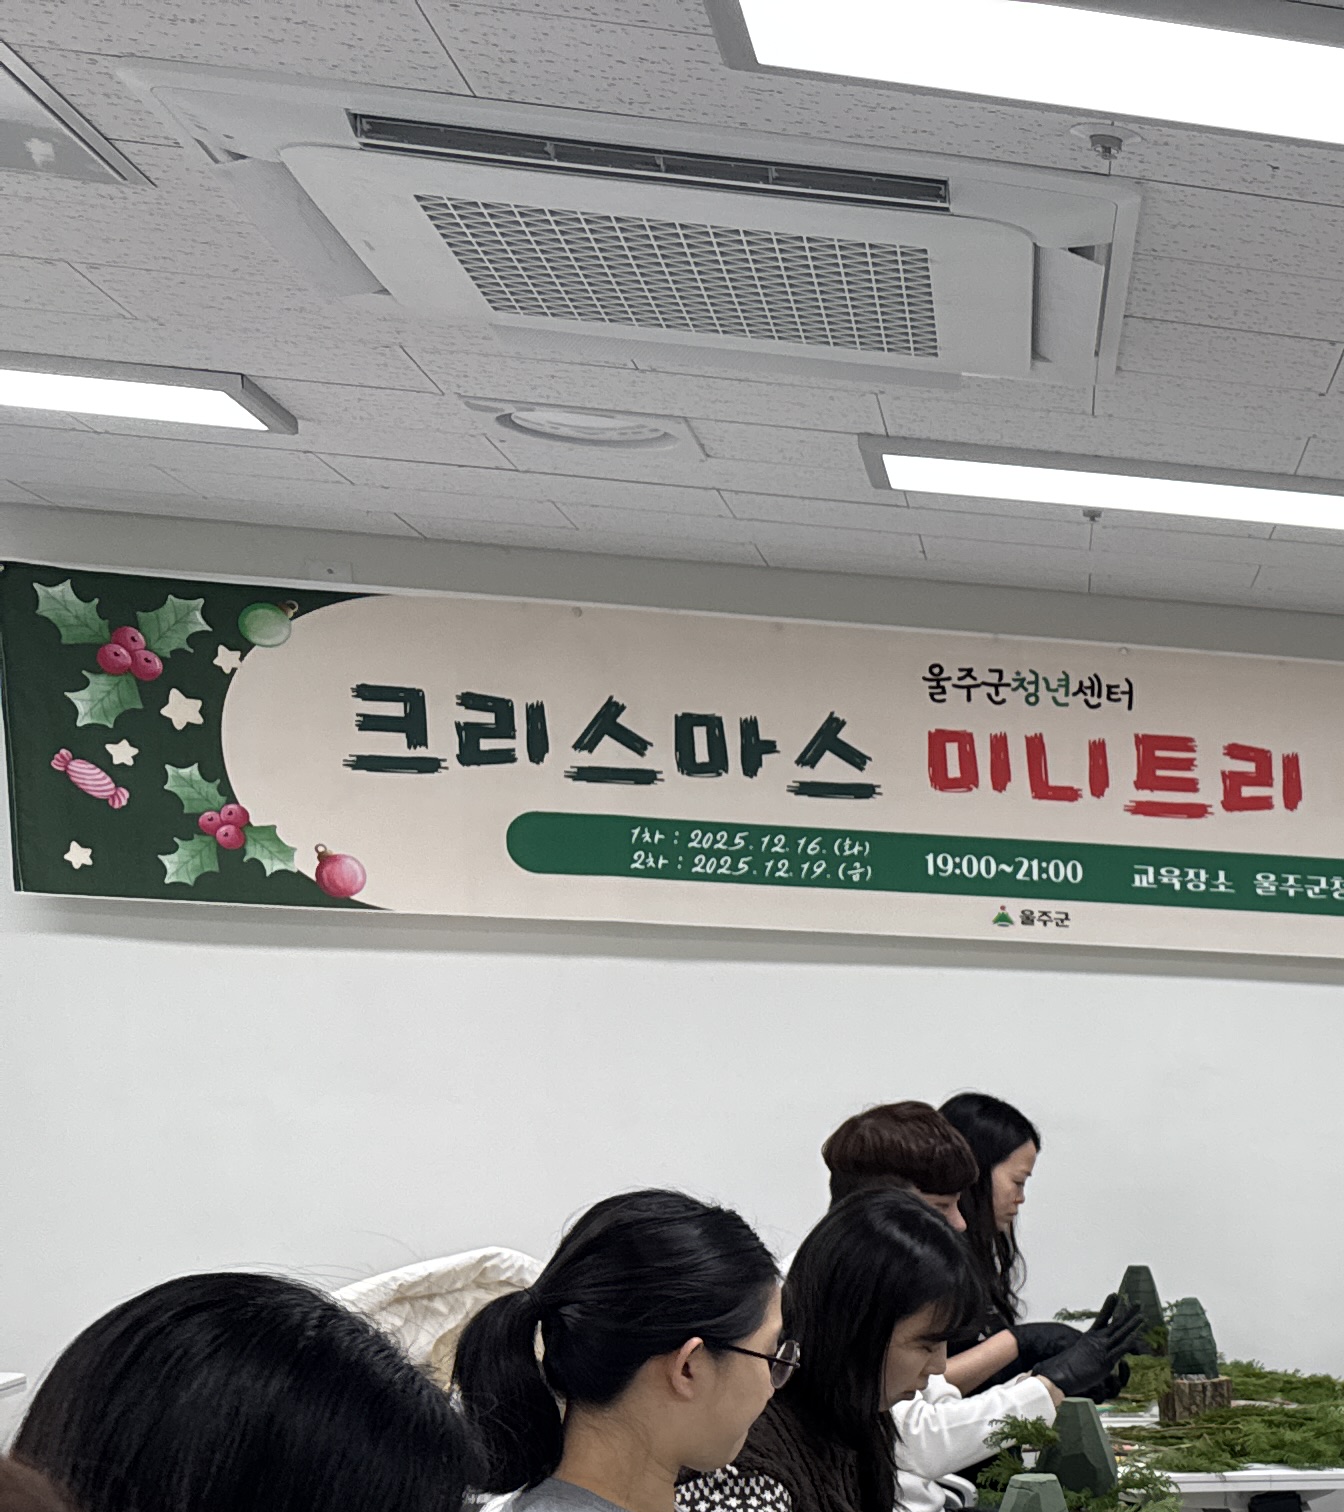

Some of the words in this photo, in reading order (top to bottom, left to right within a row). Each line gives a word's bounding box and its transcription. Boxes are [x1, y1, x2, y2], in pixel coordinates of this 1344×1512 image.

[922, 663, 1134, 711] 울주군청년센터
[343, 683, 883, 799] 크리스마스
[927, 728, 1303, 819] 미니트리
[631, 826, 665, 844] 1차
[630, 851, 669, 869] 2차
[925, 852, 1083, 883] 19:00~21:00
[1131, 864, 1235, 893] 교육장소
[1019, 909, 1070, 927] 울주군
